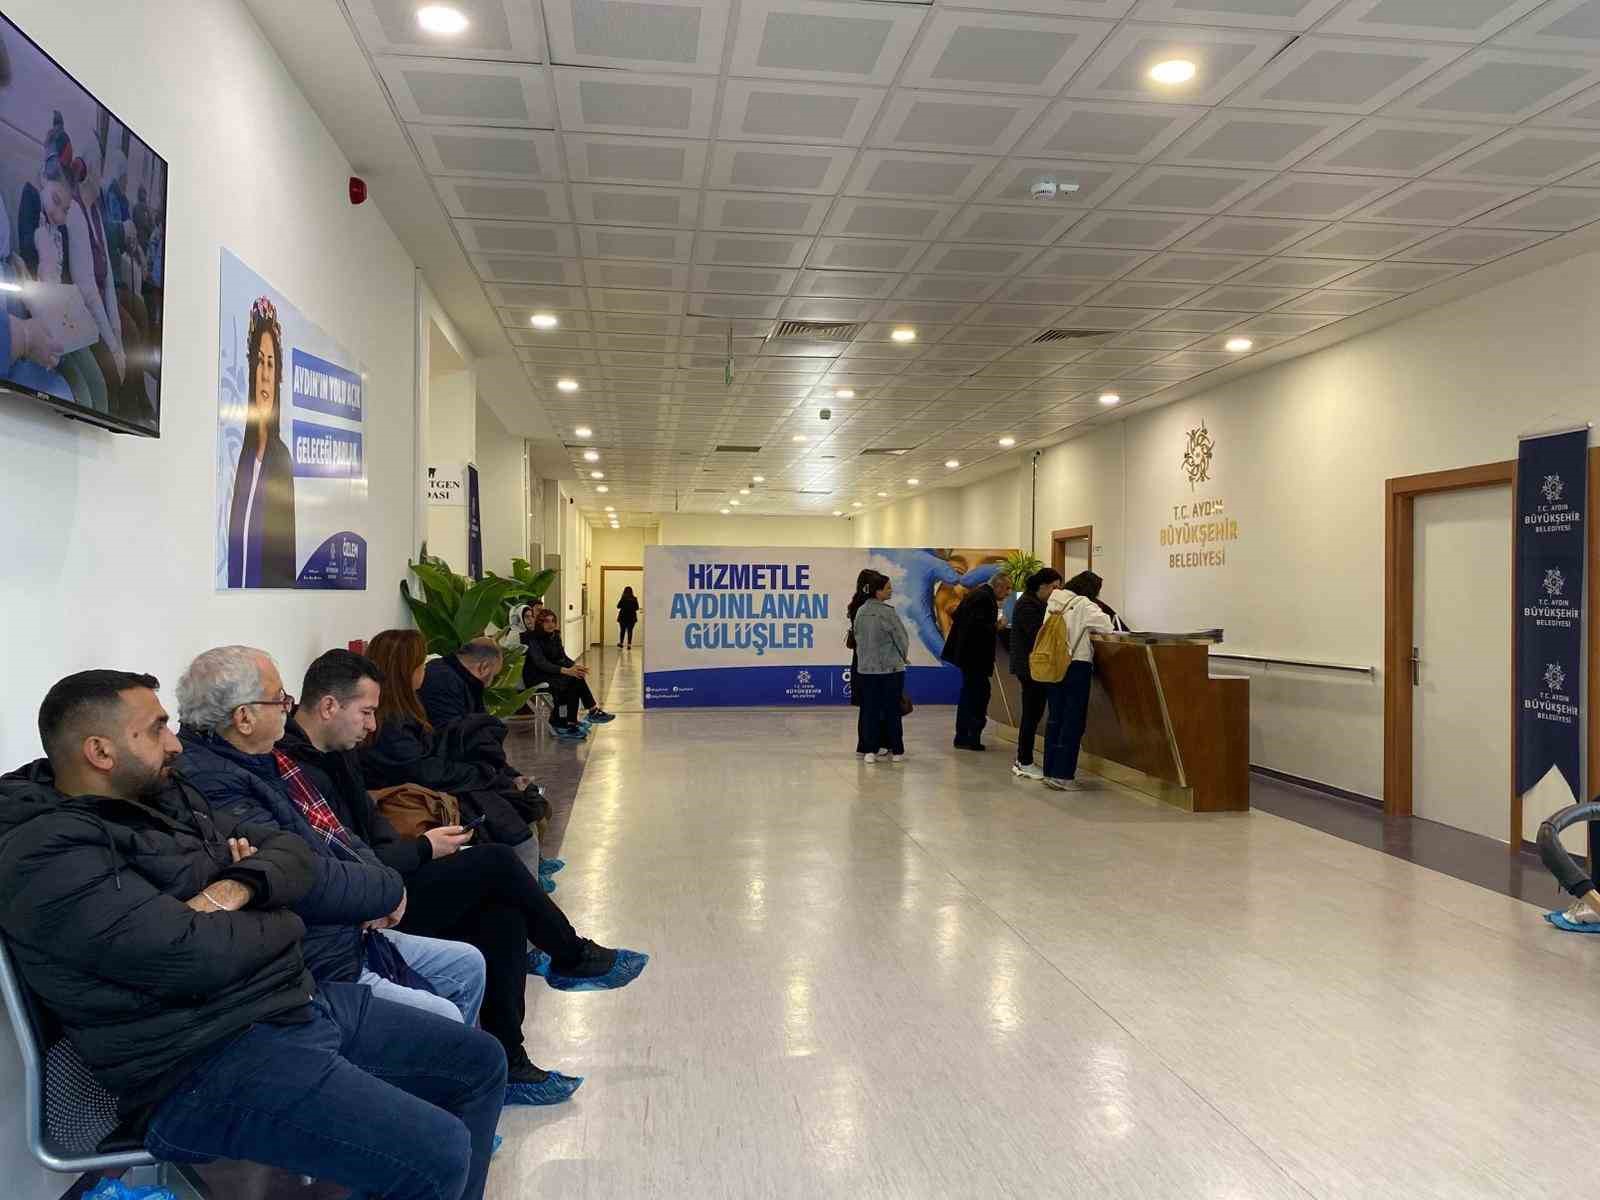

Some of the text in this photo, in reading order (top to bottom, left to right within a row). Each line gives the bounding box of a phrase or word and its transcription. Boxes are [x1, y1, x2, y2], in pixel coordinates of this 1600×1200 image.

[428, 480, 460, 488] TGEN
[1192, 499, 1223, 518] AYDIN
[1524, 511, 1580, 525] BÜYÜKŞEHİR
[1160, 517, 1238, 547] BÜYÜKŞEHİR
[1169, 549, 1225, 569] BELEDİYESİ
[688, 564, 810, 590] HİZMETLE
[670, 593, 829, 619] AYDINLANAN
[1524, 606, 1579, 619] BÜYÜKŞEHİR
[685, 622, 814, 656] GÜLÜŞLER
[1524, 698, 1578, 716] BÜYÜKŞEHİR
